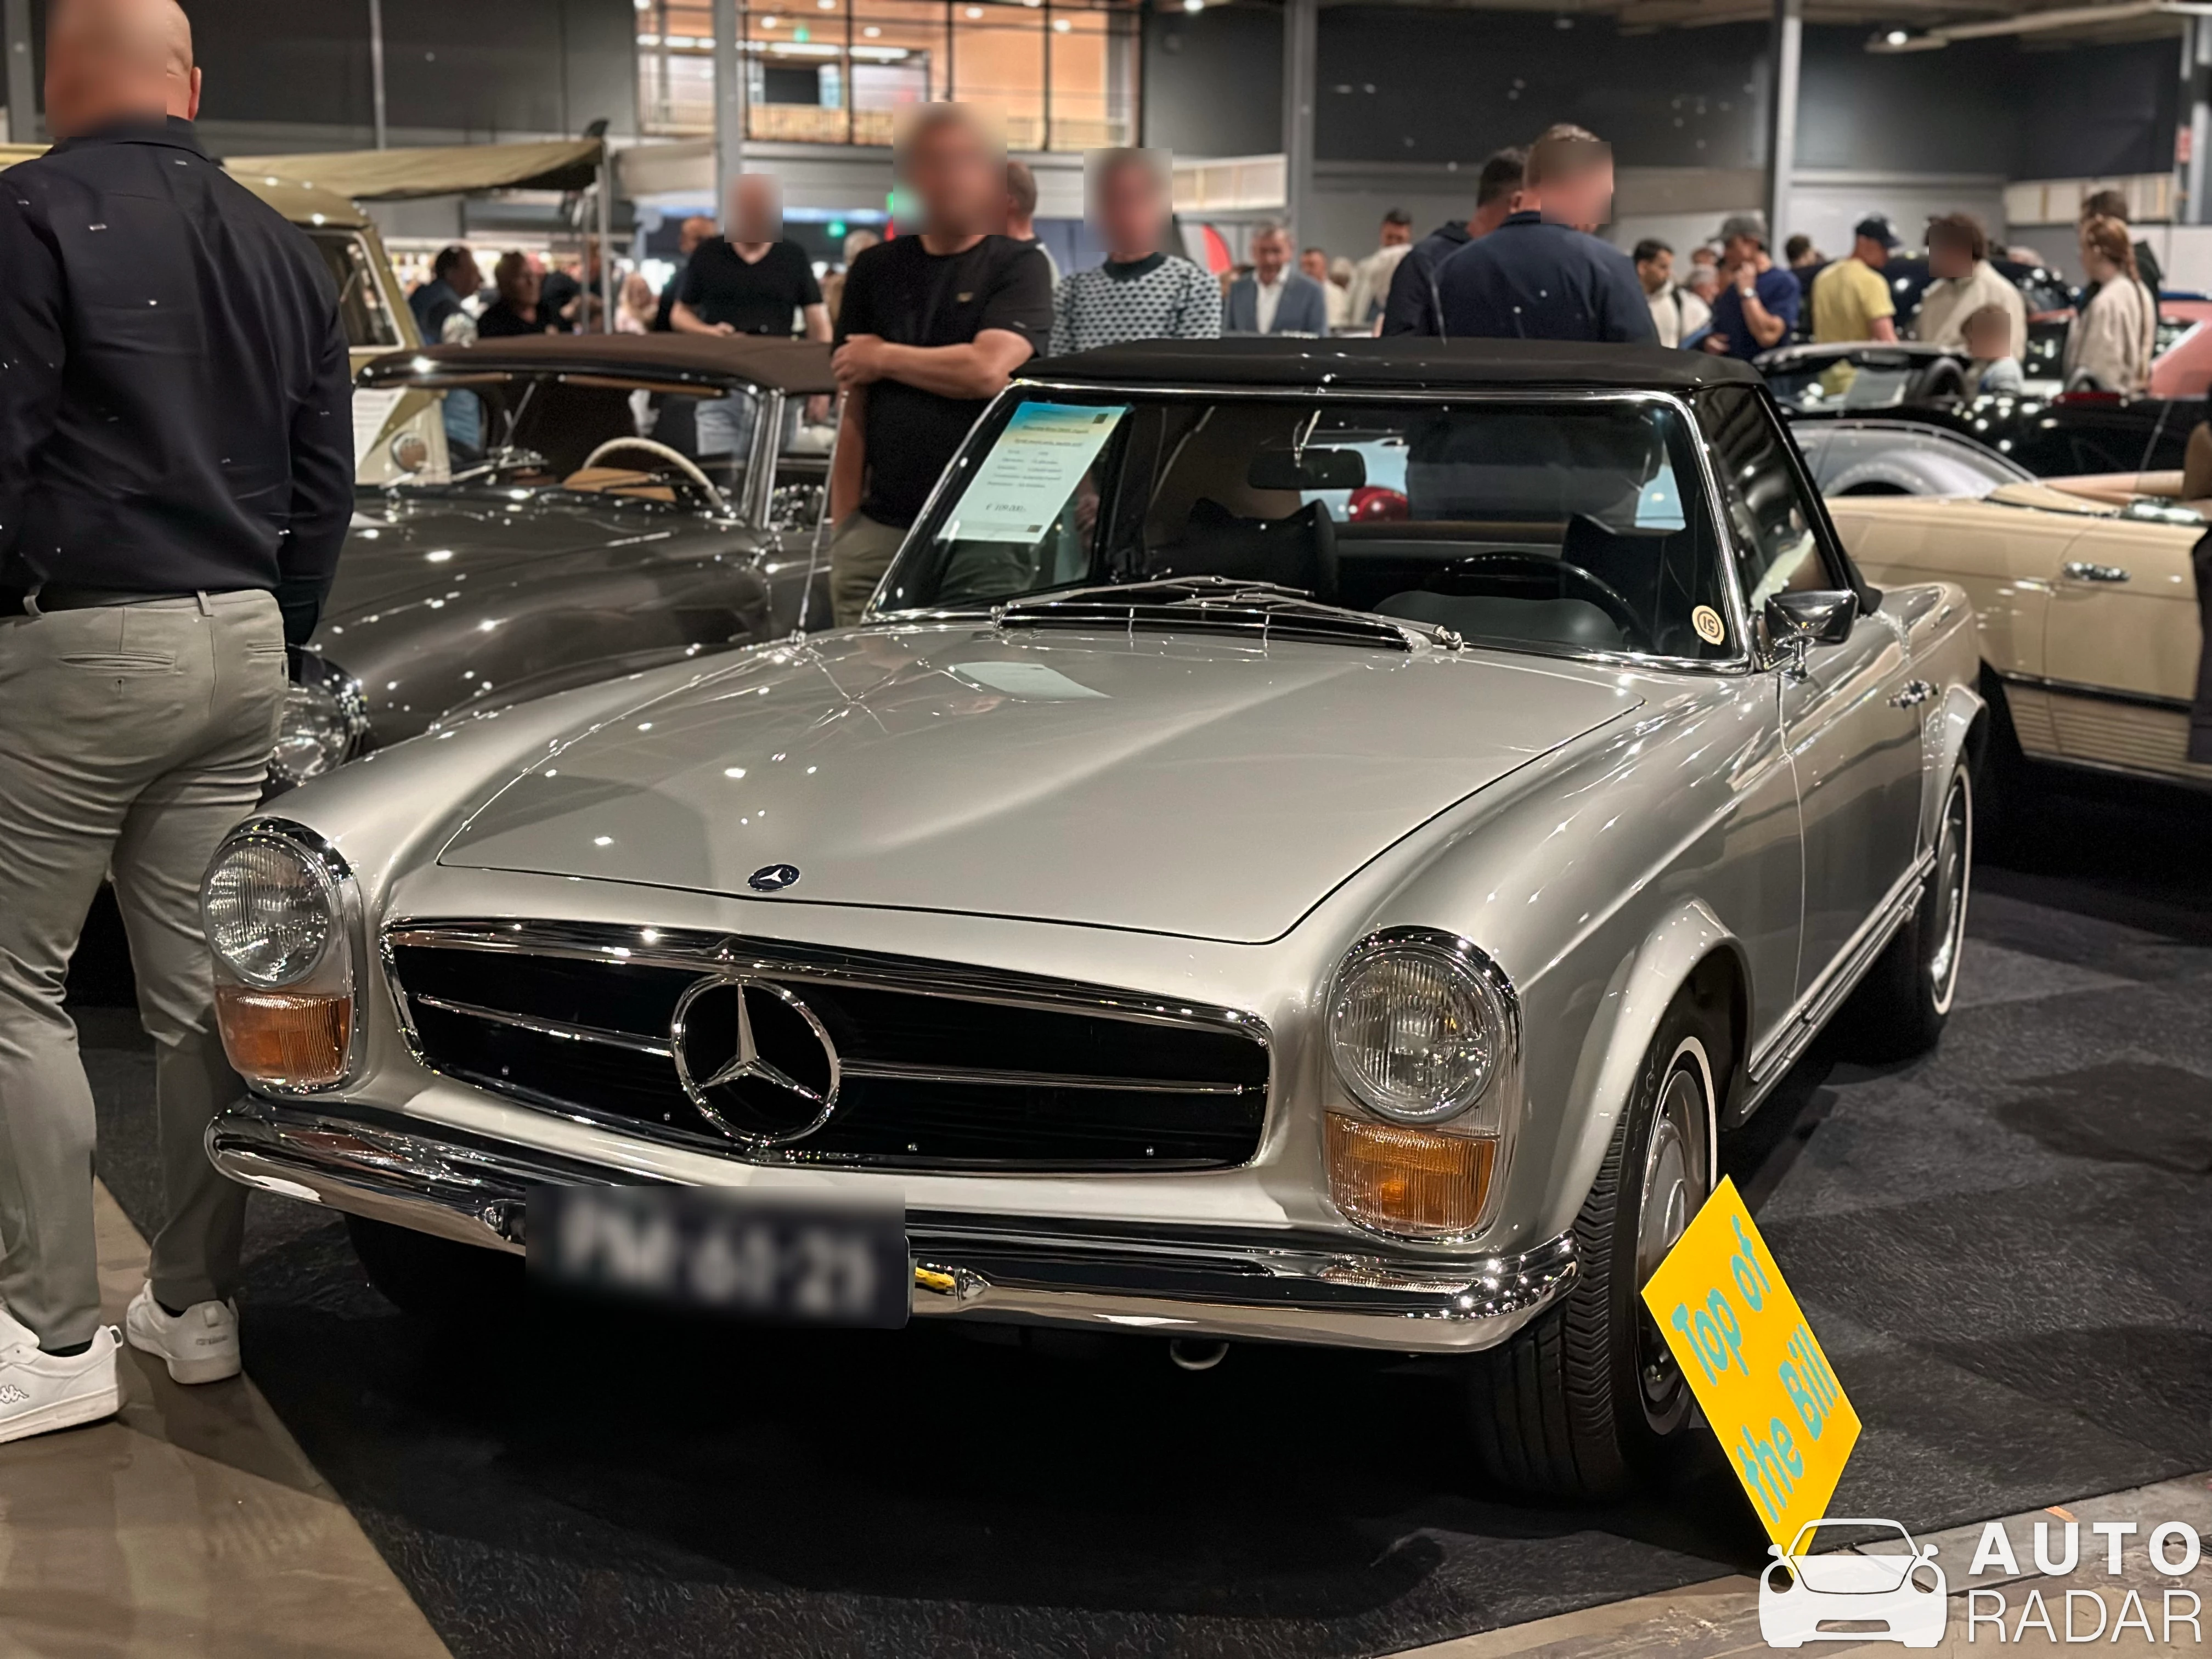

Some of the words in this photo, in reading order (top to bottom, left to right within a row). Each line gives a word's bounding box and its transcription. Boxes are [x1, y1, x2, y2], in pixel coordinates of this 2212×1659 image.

[1672, 1301, 1749, 1386] Top
[1731, 1214, 1772, 1312] of
[1736, 1423, 1805, 1525] the
[1779, 1322, 1839, 1441] Bill
